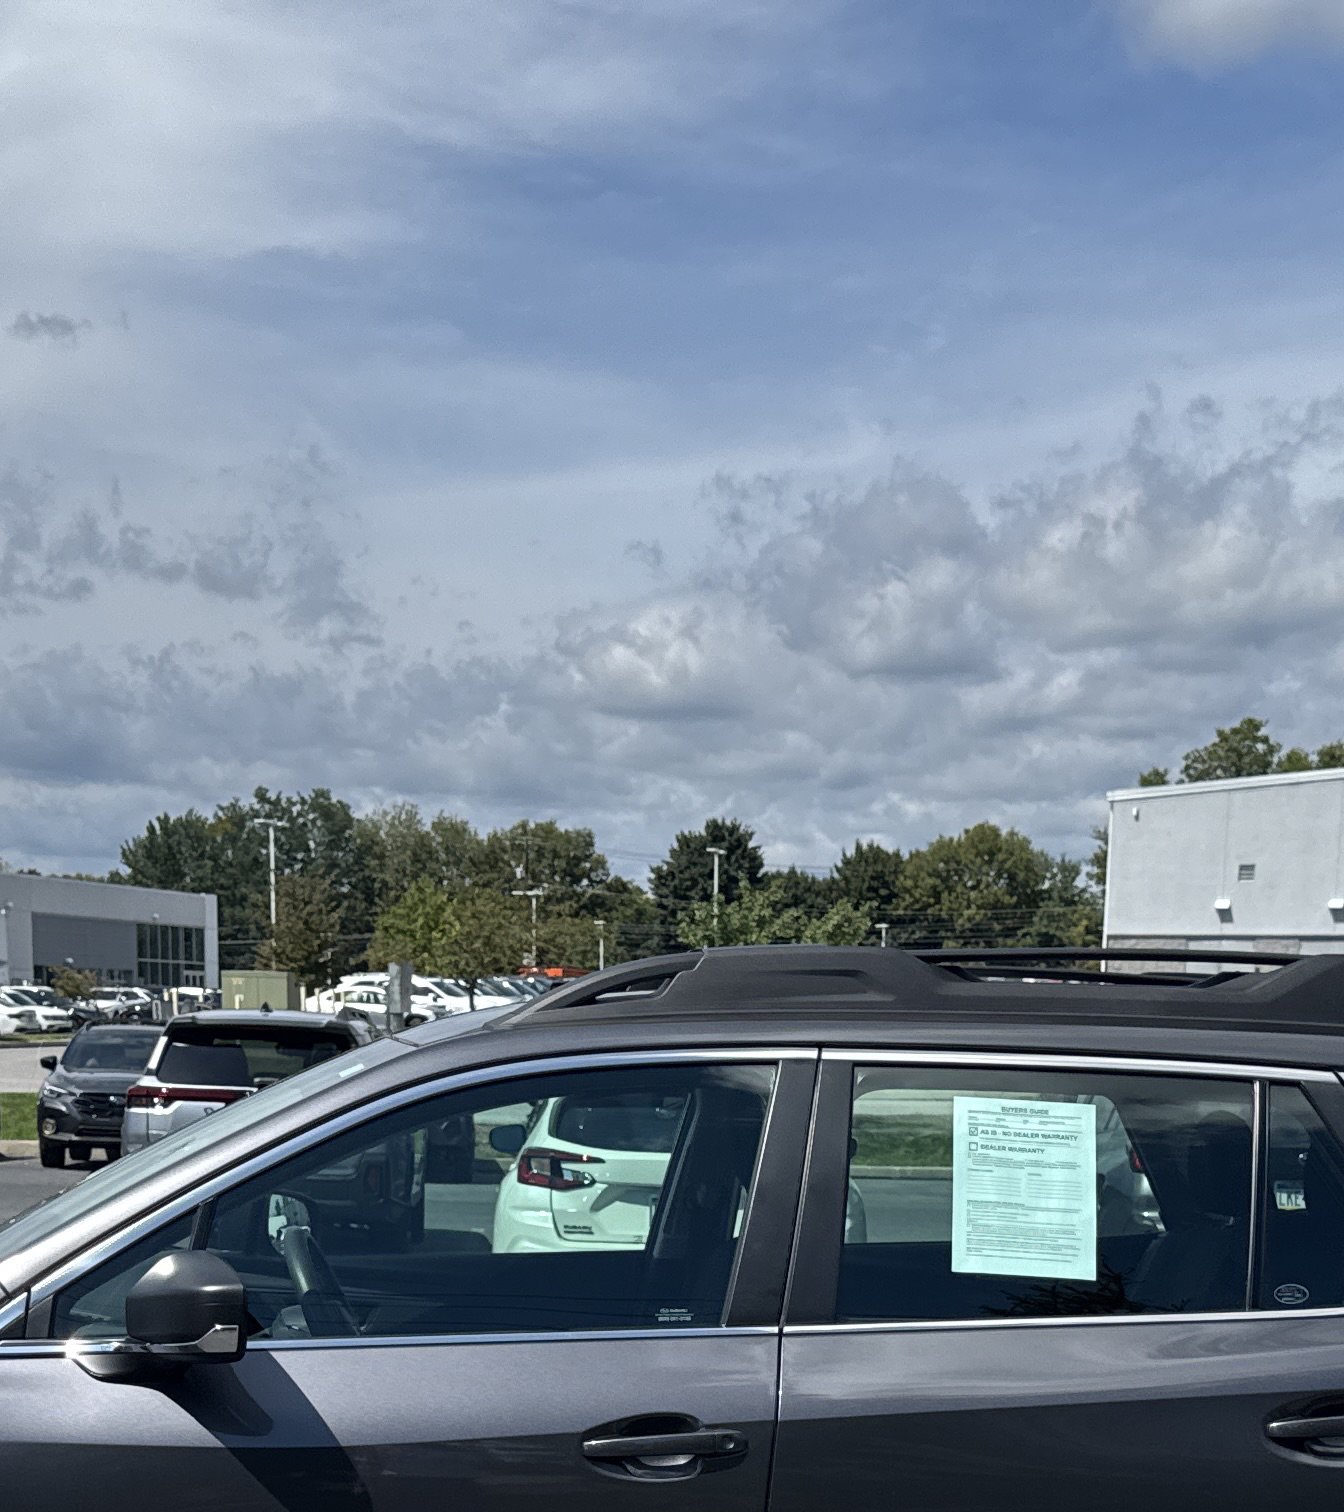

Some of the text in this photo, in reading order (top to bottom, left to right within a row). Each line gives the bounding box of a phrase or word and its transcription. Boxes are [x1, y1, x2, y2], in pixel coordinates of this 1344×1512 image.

[1013, 1131, 1040, 1139] DEALER
[1041, 1133, 1079, 1142] WARRANTY
[980, 1144, 1046, 1154] DEALER WARRANTY
